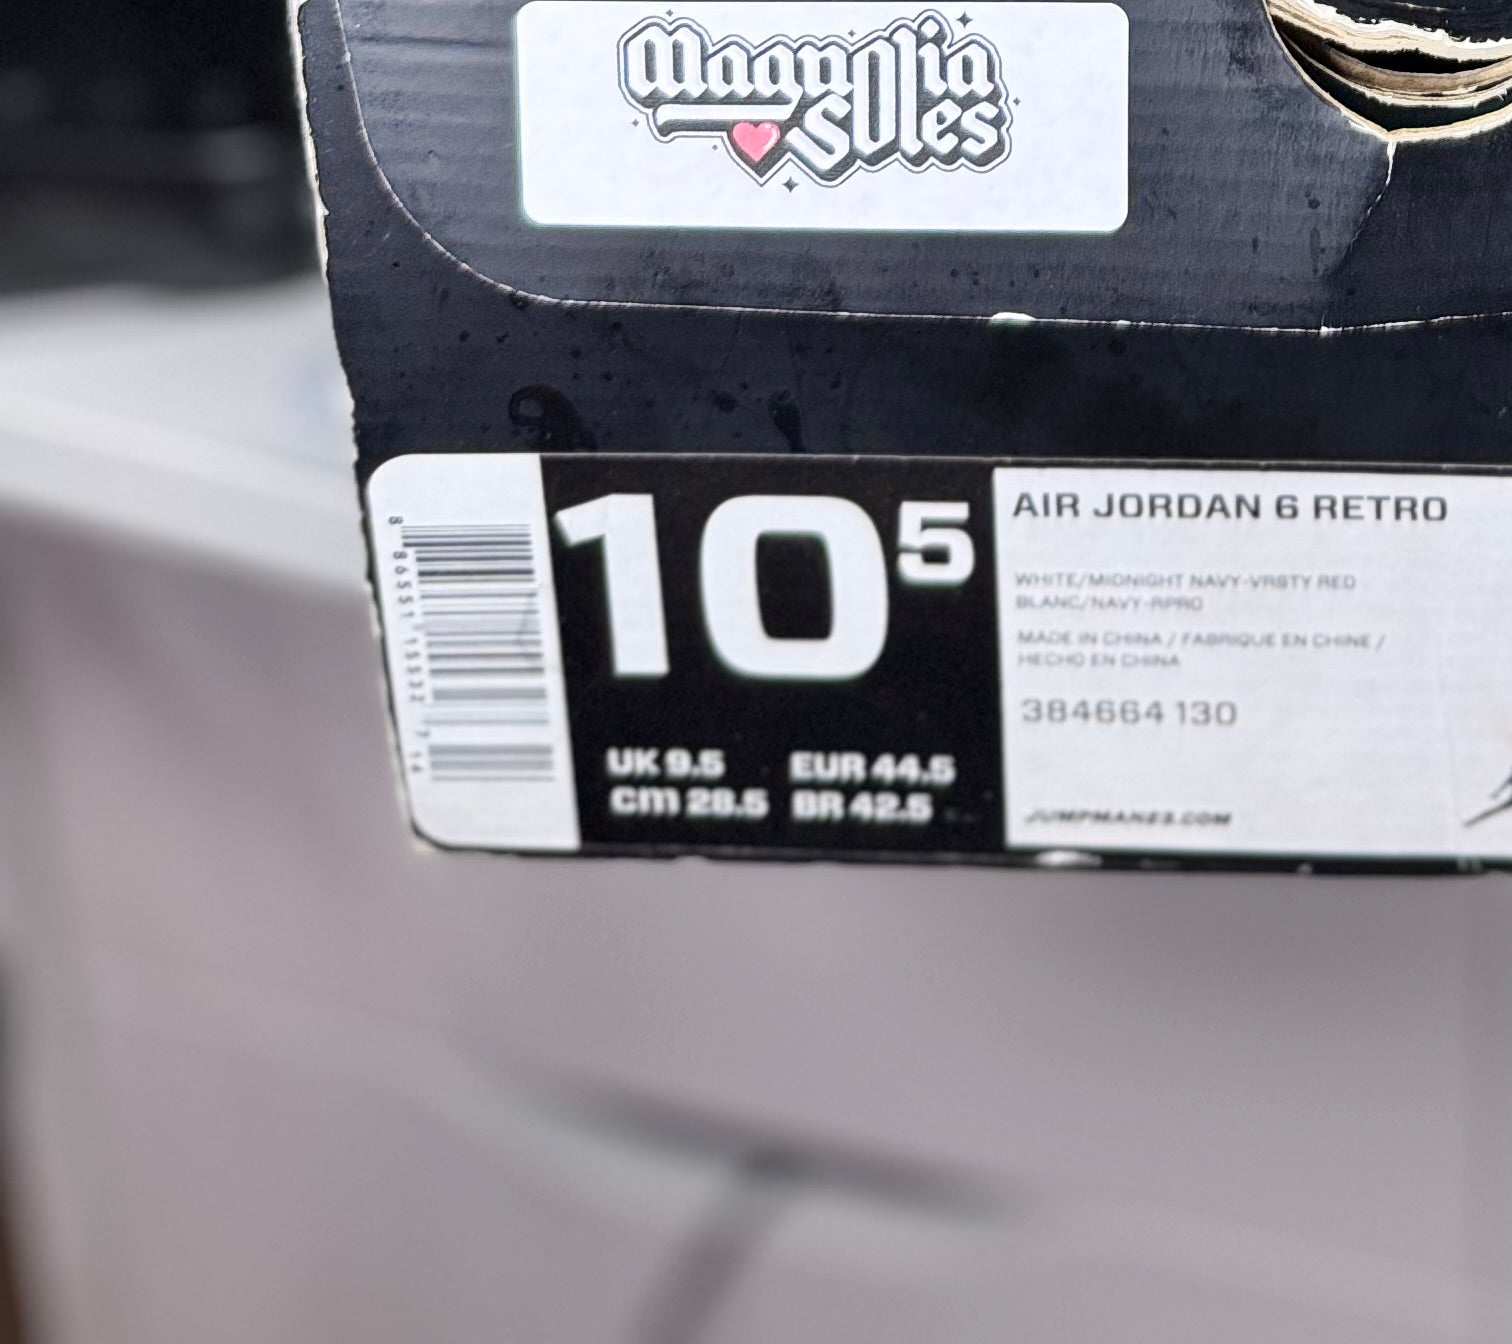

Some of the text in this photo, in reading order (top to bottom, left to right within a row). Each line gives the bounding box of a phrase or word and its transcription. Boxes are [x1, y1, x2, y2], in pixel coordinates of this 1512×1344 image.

[1013, 492, 1447, 521] AIR JORDAN 6 RETRO
[556, 493, 888, 680] 10
[1318, 575, 1356, 590] RED
[1017, 630, 1071, 645] MADE
[1079, 631, 1097, 645] IN
[1103, 631, 1162, 646] CHINA
[1181, 632, 1275, 647] FABRIQUE
[1282, 633, 1307, 647] EN
[1312, 634, 1370, 648] CHINE
[1017, 652, 1181, 668] HECHO EN CHINA
[606, 747, 726, 780] UK 9.5
[789, 751, 956, 785] EUR 44.5
[848, 791, 934, 824] 42.5
